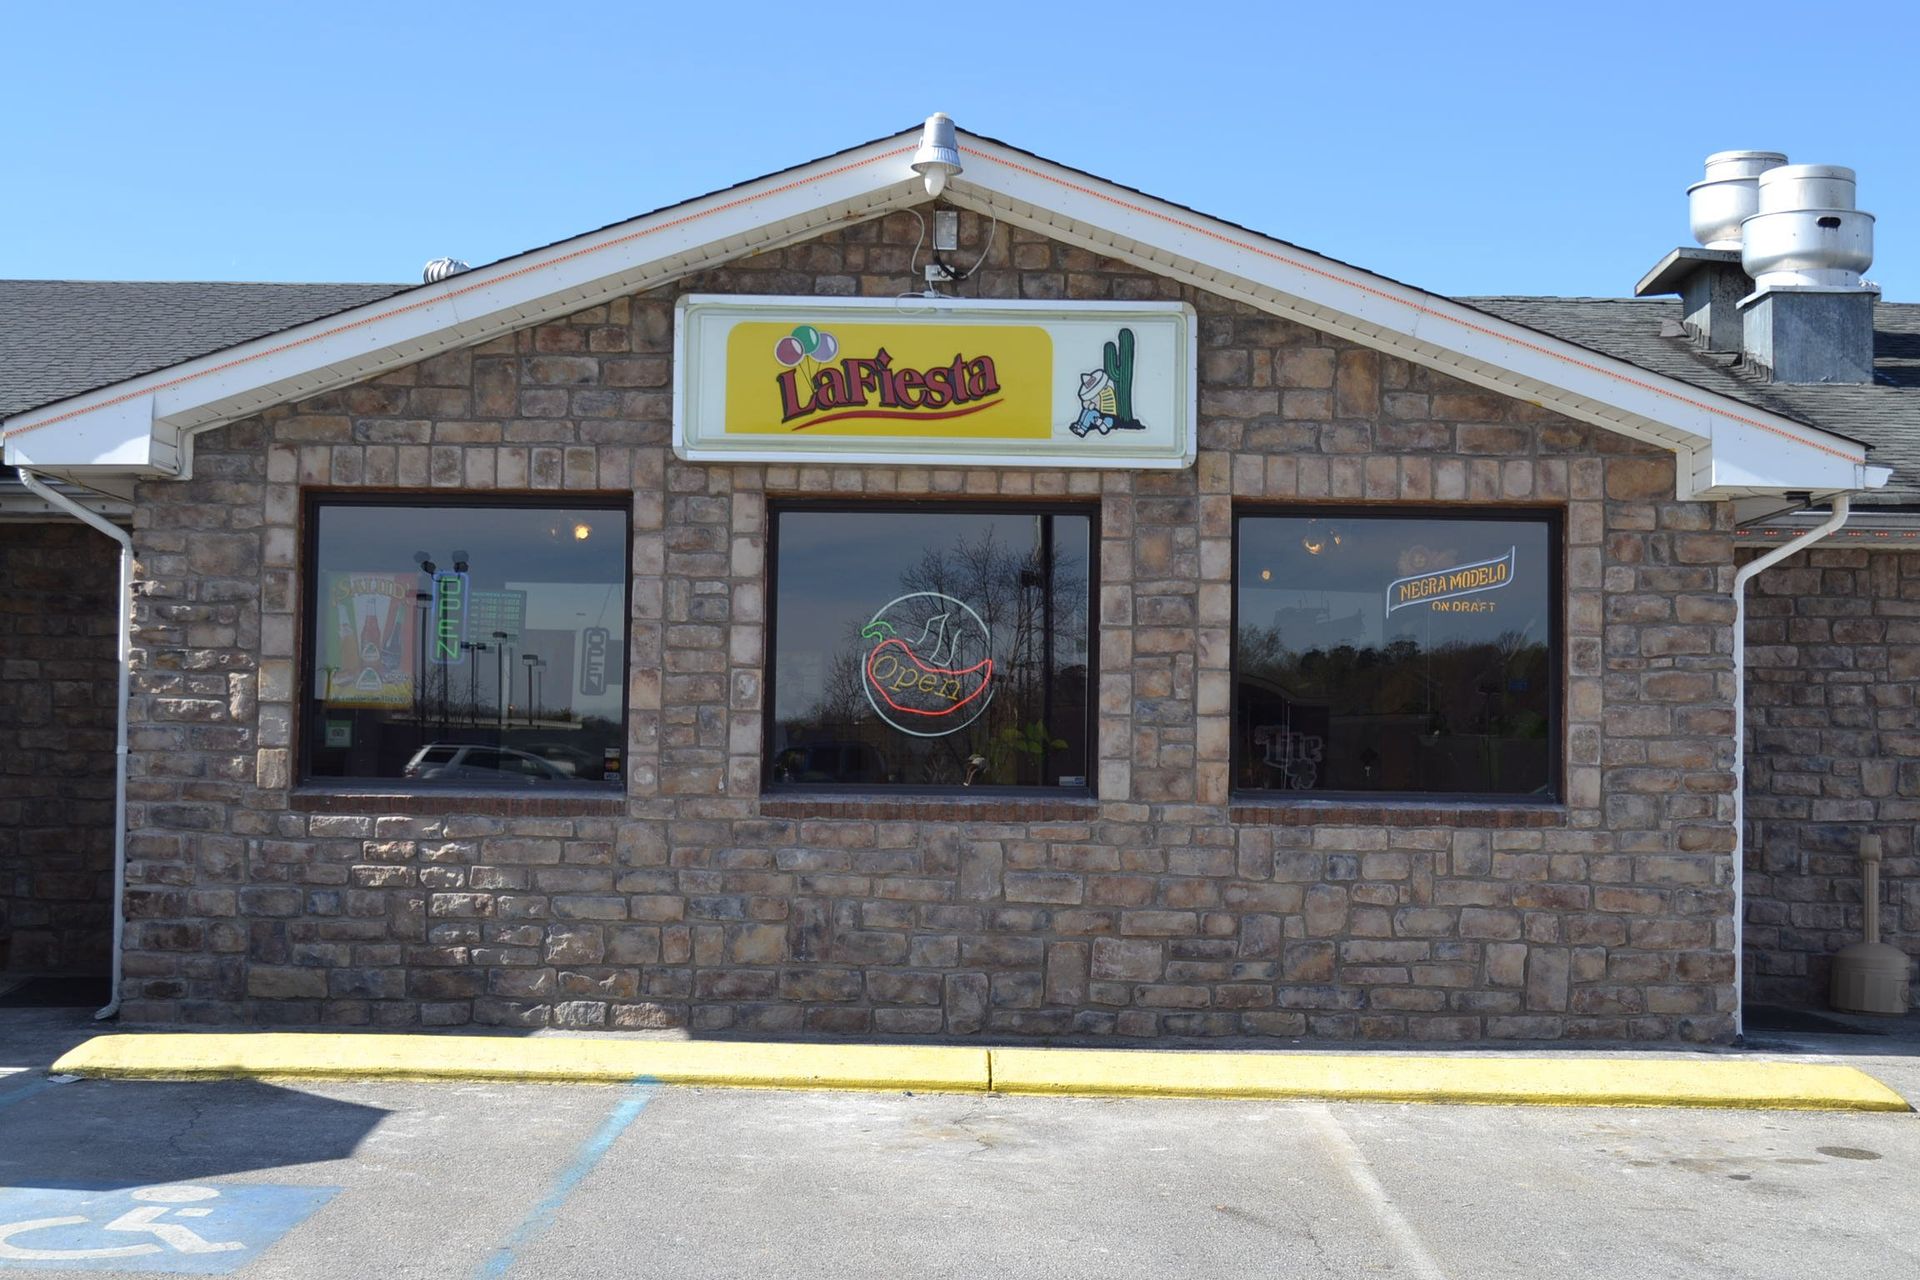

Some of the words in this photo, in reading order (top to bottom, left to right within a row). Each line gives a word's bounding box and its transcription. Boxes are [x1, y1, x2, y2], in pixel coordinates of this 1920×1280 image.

[776, 347, 1001, 424] LaFiesta
[1400, 575, 1447, 602] NEGRA
[1449, 563, 1506, 591] MODELO
[437, 575, 461, 659] OPEN
[1432, 601, 1449, 612] ON
[1452, 601, 1496, 612] DRAFT
[873, 655, 960, 700] Open
